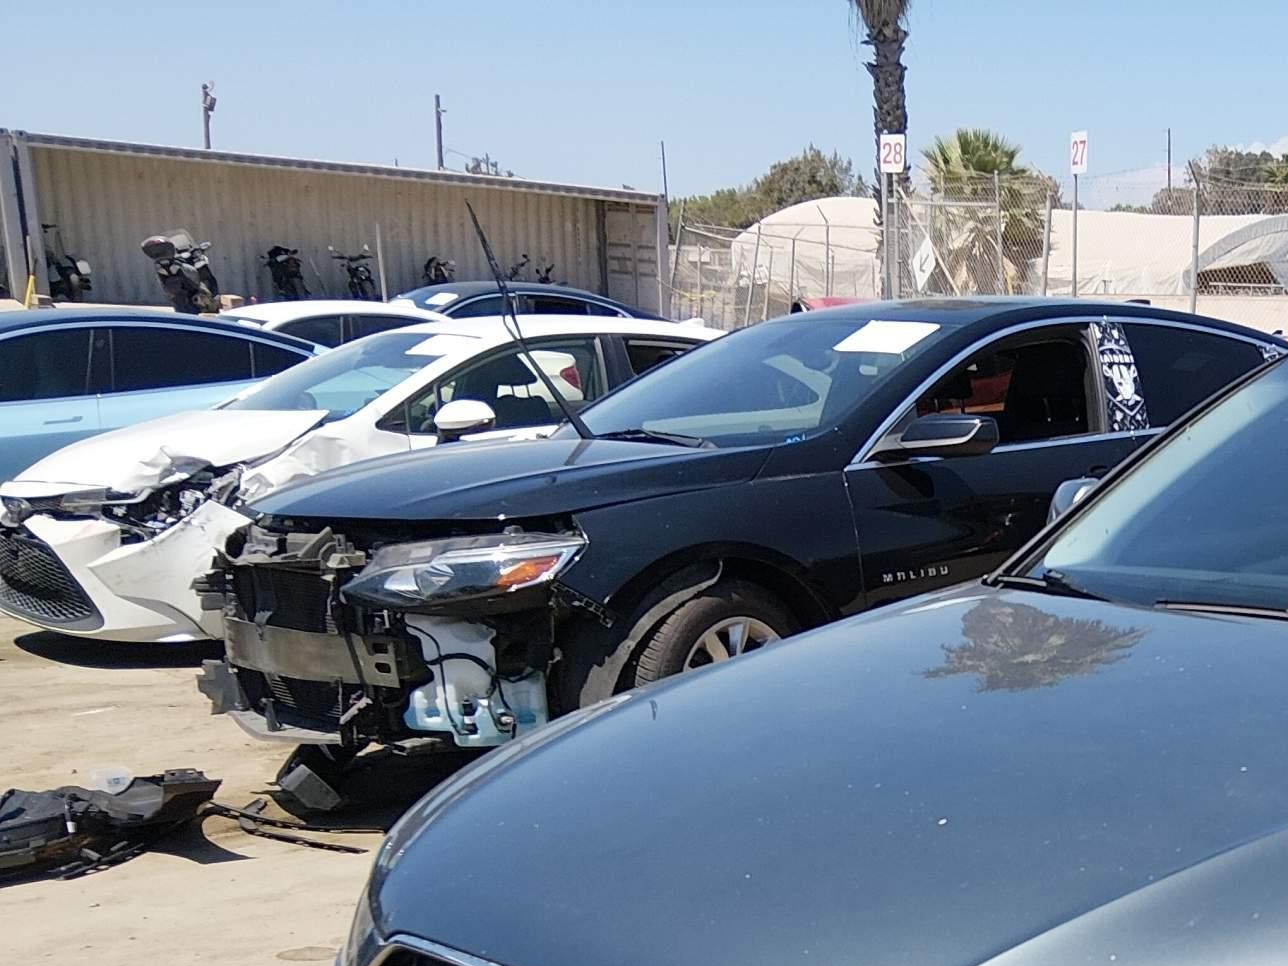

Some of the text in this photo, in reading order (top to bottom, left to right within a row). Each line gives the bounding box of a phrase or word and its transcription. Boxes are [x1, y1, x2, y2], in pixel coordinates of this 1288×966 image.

[882, 142, 903, 164] 28
[1072, 140, 1087, 166] 27
[882, 565, 949, 583] MALIBU
